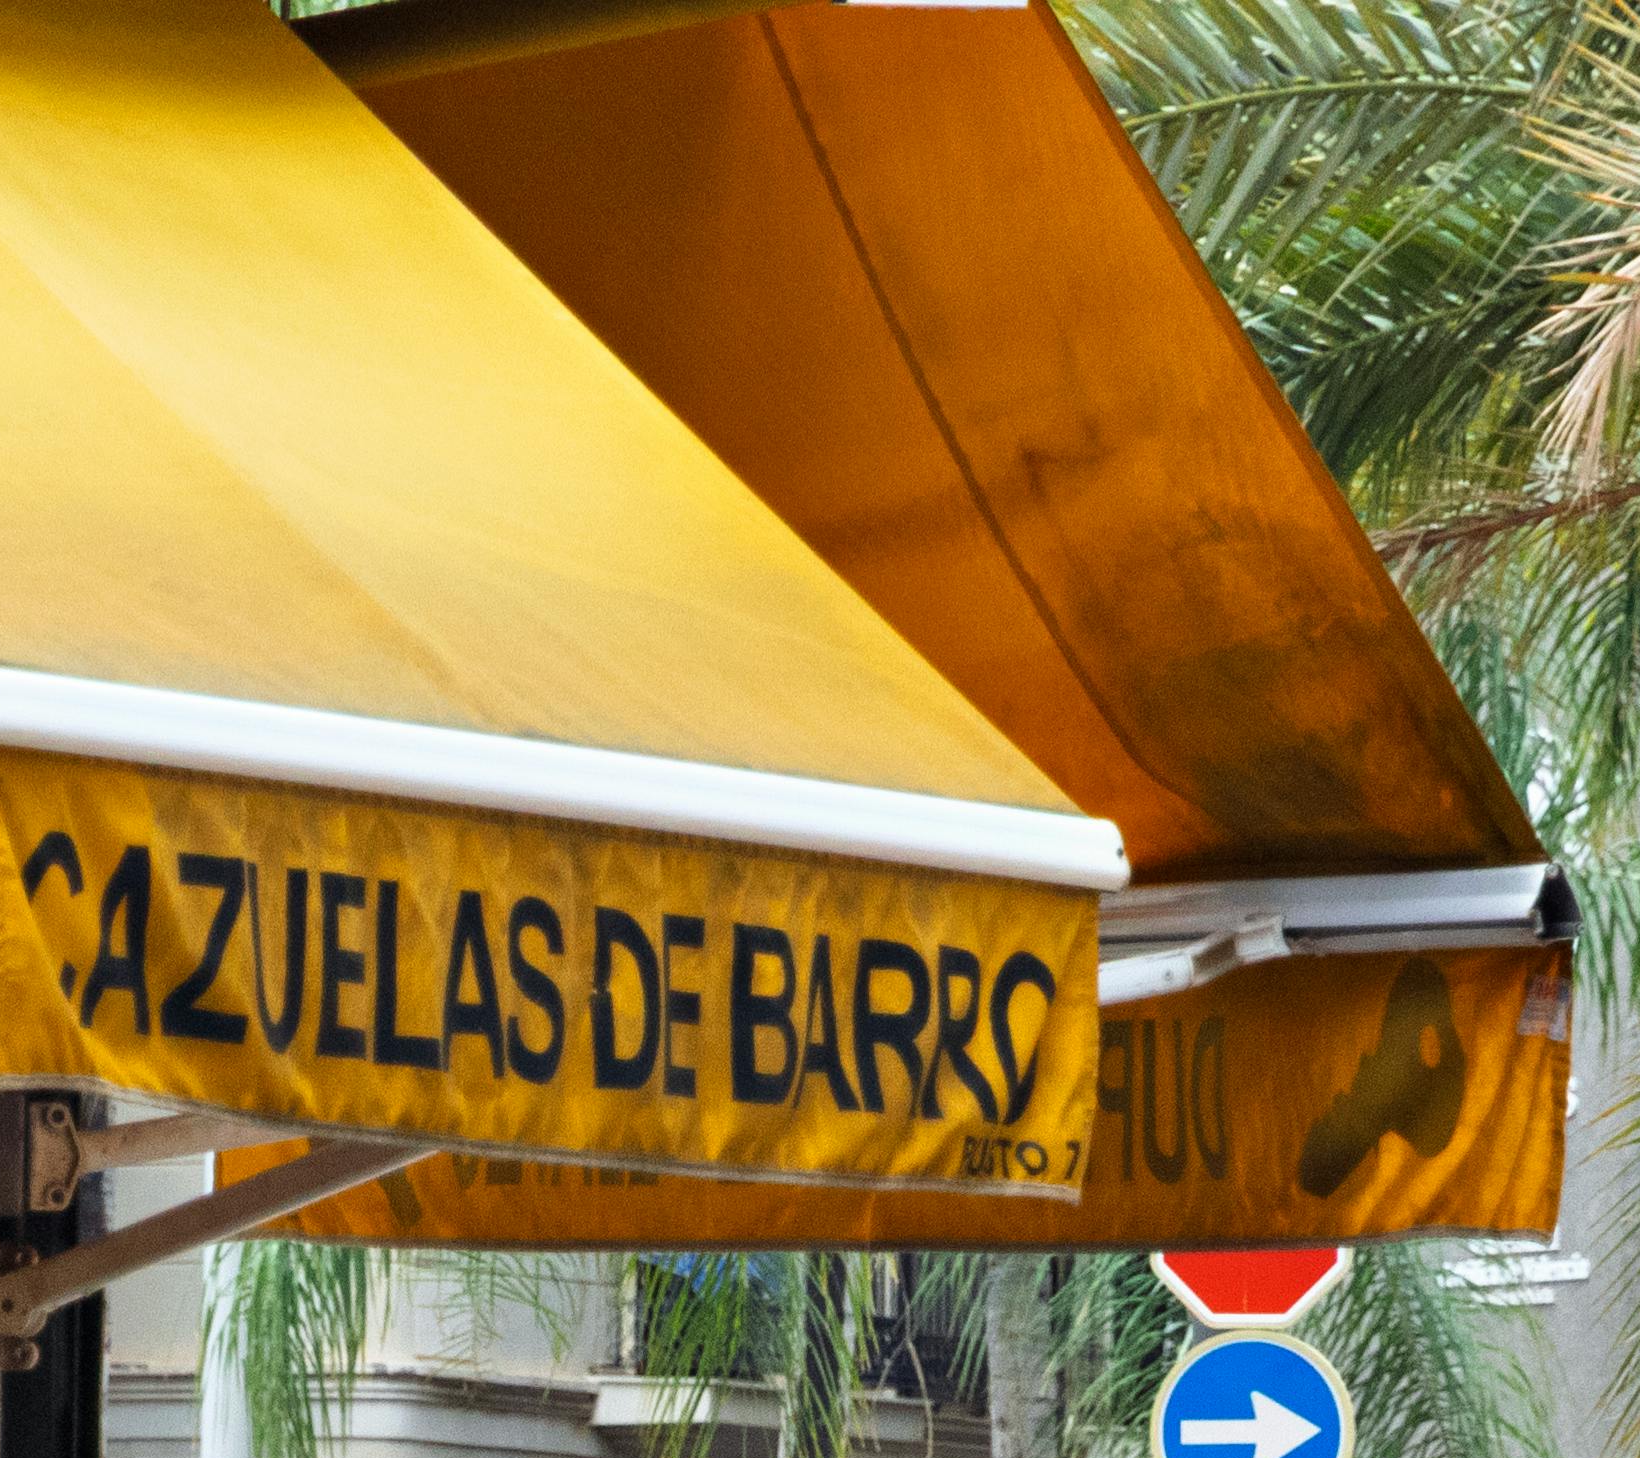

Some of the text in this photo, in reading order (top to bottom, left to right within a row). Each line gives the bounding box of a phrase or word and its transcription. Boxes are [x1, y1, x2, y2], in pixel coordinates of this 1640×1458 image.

[22, 832, 1055, 1126] CAZUELAS DE BARRO
